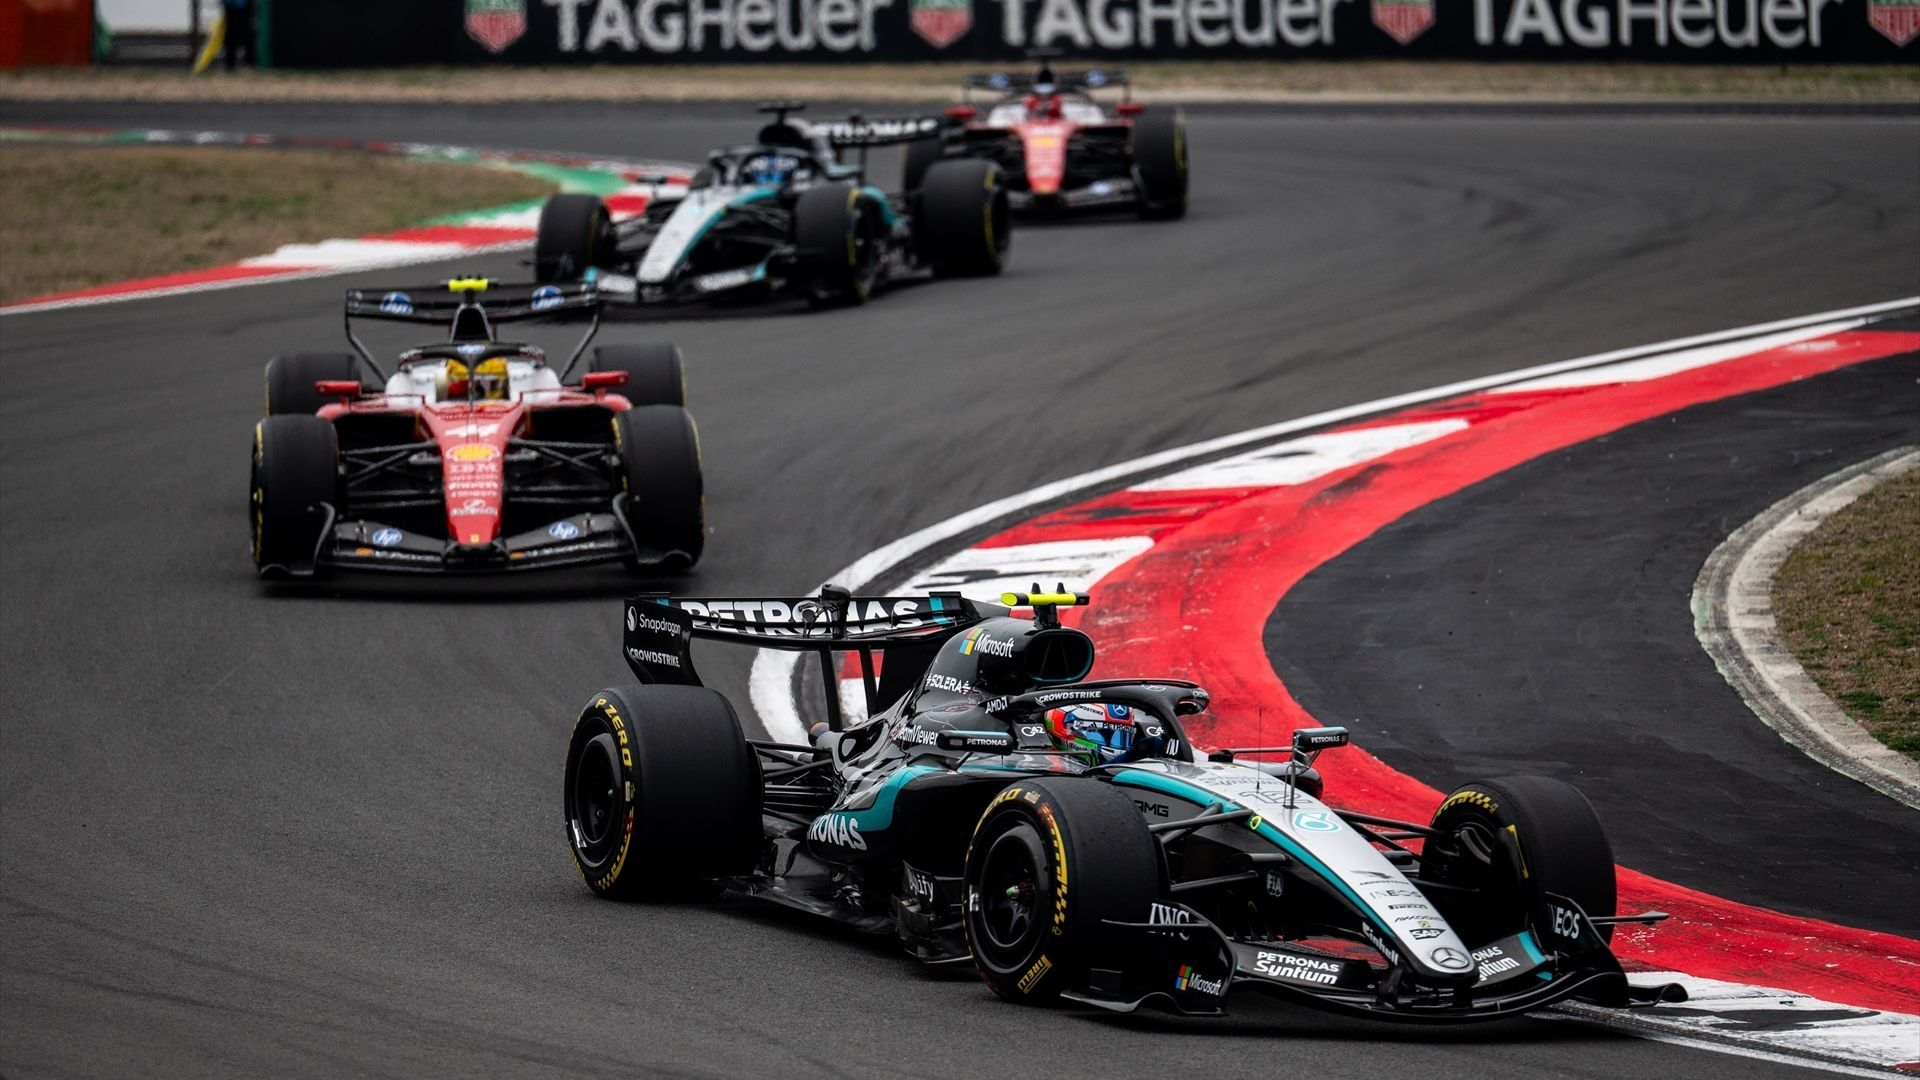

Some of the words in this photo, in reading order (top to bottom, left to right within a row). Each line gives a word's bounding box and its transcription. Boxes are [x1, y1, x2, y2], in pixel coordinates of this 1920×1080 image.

[376, 528, 400, 545] hp
[553, 521, 577, 539] hp
[639, 613, 681, 637] Snapdragon
[974, 633, 1014, 658] Microsoft
[629, 647, 681, 668] CROWDSTRIKE
[929, 673, 963, 693] SOLERA
[985, 698, 1003, 714] AMD
[1038, 690, 1102, 704] CROWDSTRIKE
[595, 698, 607, 708] P
[605, 704, 632, 767] ZERO
[966, 738, 1008, 746] PETRONAS
[1311, 735, 1340, 744] PETRONAS
[806, 813, 867, 851] RONAS
[1369, 889, 1422, 900] INEOS
[1147, 902, 1190, 940] IWC
[1362, 921, 1398, 966] Einhell
[1410, 929, 1440, 939] SAP
[1257, 951, 1340, 973] PETRONAS
[1472, 946, 1503, 961] ONAS
[1253, 960, 1338, 985] Syntium
[1188, 972, 1222, 996] Microsoft
